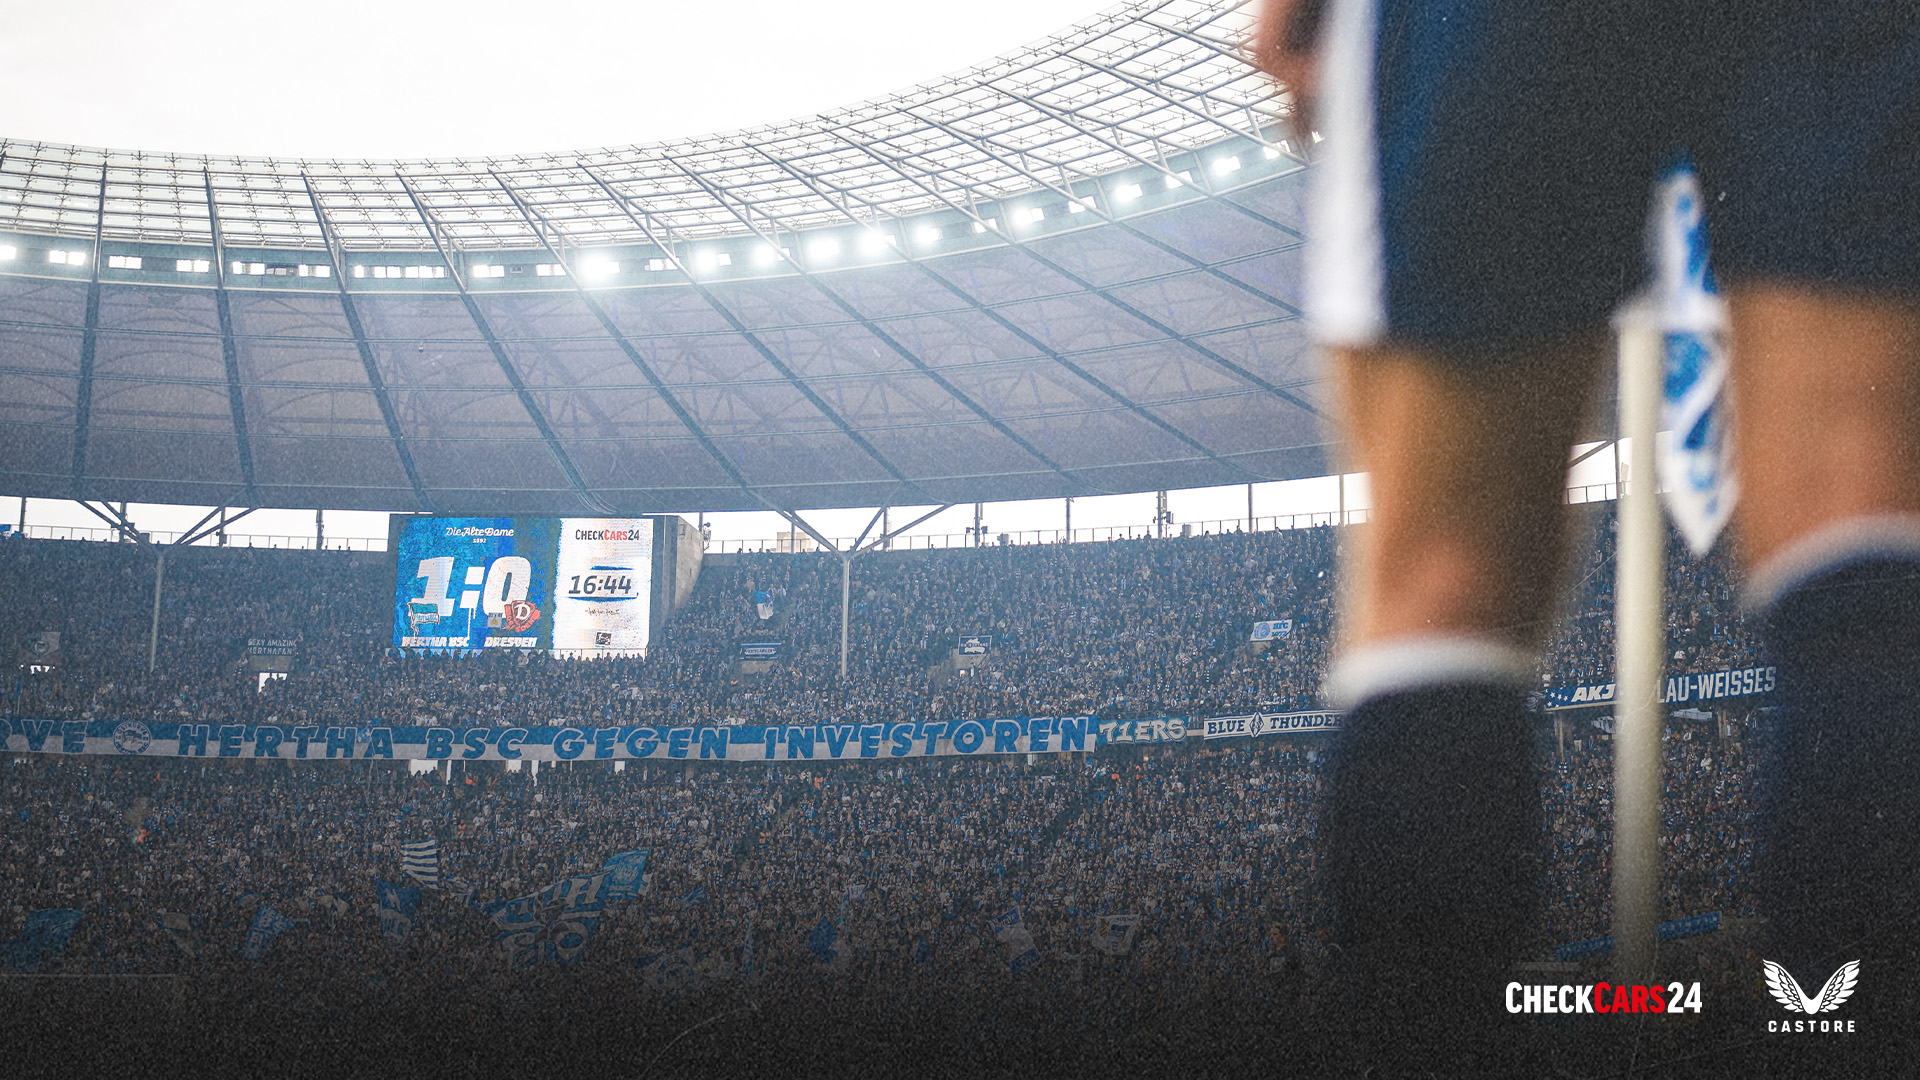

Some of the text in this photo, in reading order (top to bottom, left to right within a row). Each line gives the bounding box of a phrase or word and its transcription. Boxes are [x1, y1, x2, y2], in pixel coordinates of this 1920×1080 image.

[575, 529, 640, 541] CHECKCARS24
[568, 575, 632, 595] 16:44
[247, 638, 266, 646] SEXY
[402, 637, 470, 647] HERTHA BSC
[484, 637, 538, 648] DRESDEN
[1655, 667, 1776, 704] LAU-WEISSES
[1099, 719, 1186, 743] 71ERS
[1207, 719, 1245, 735] BLUE
[177, 724, 395, 759] HERTHA
[425, 727, 529, 760] BSC
[553, 726, 731, 760] GEGEN
[763, 716, 1089, 760] INVESTOREN
